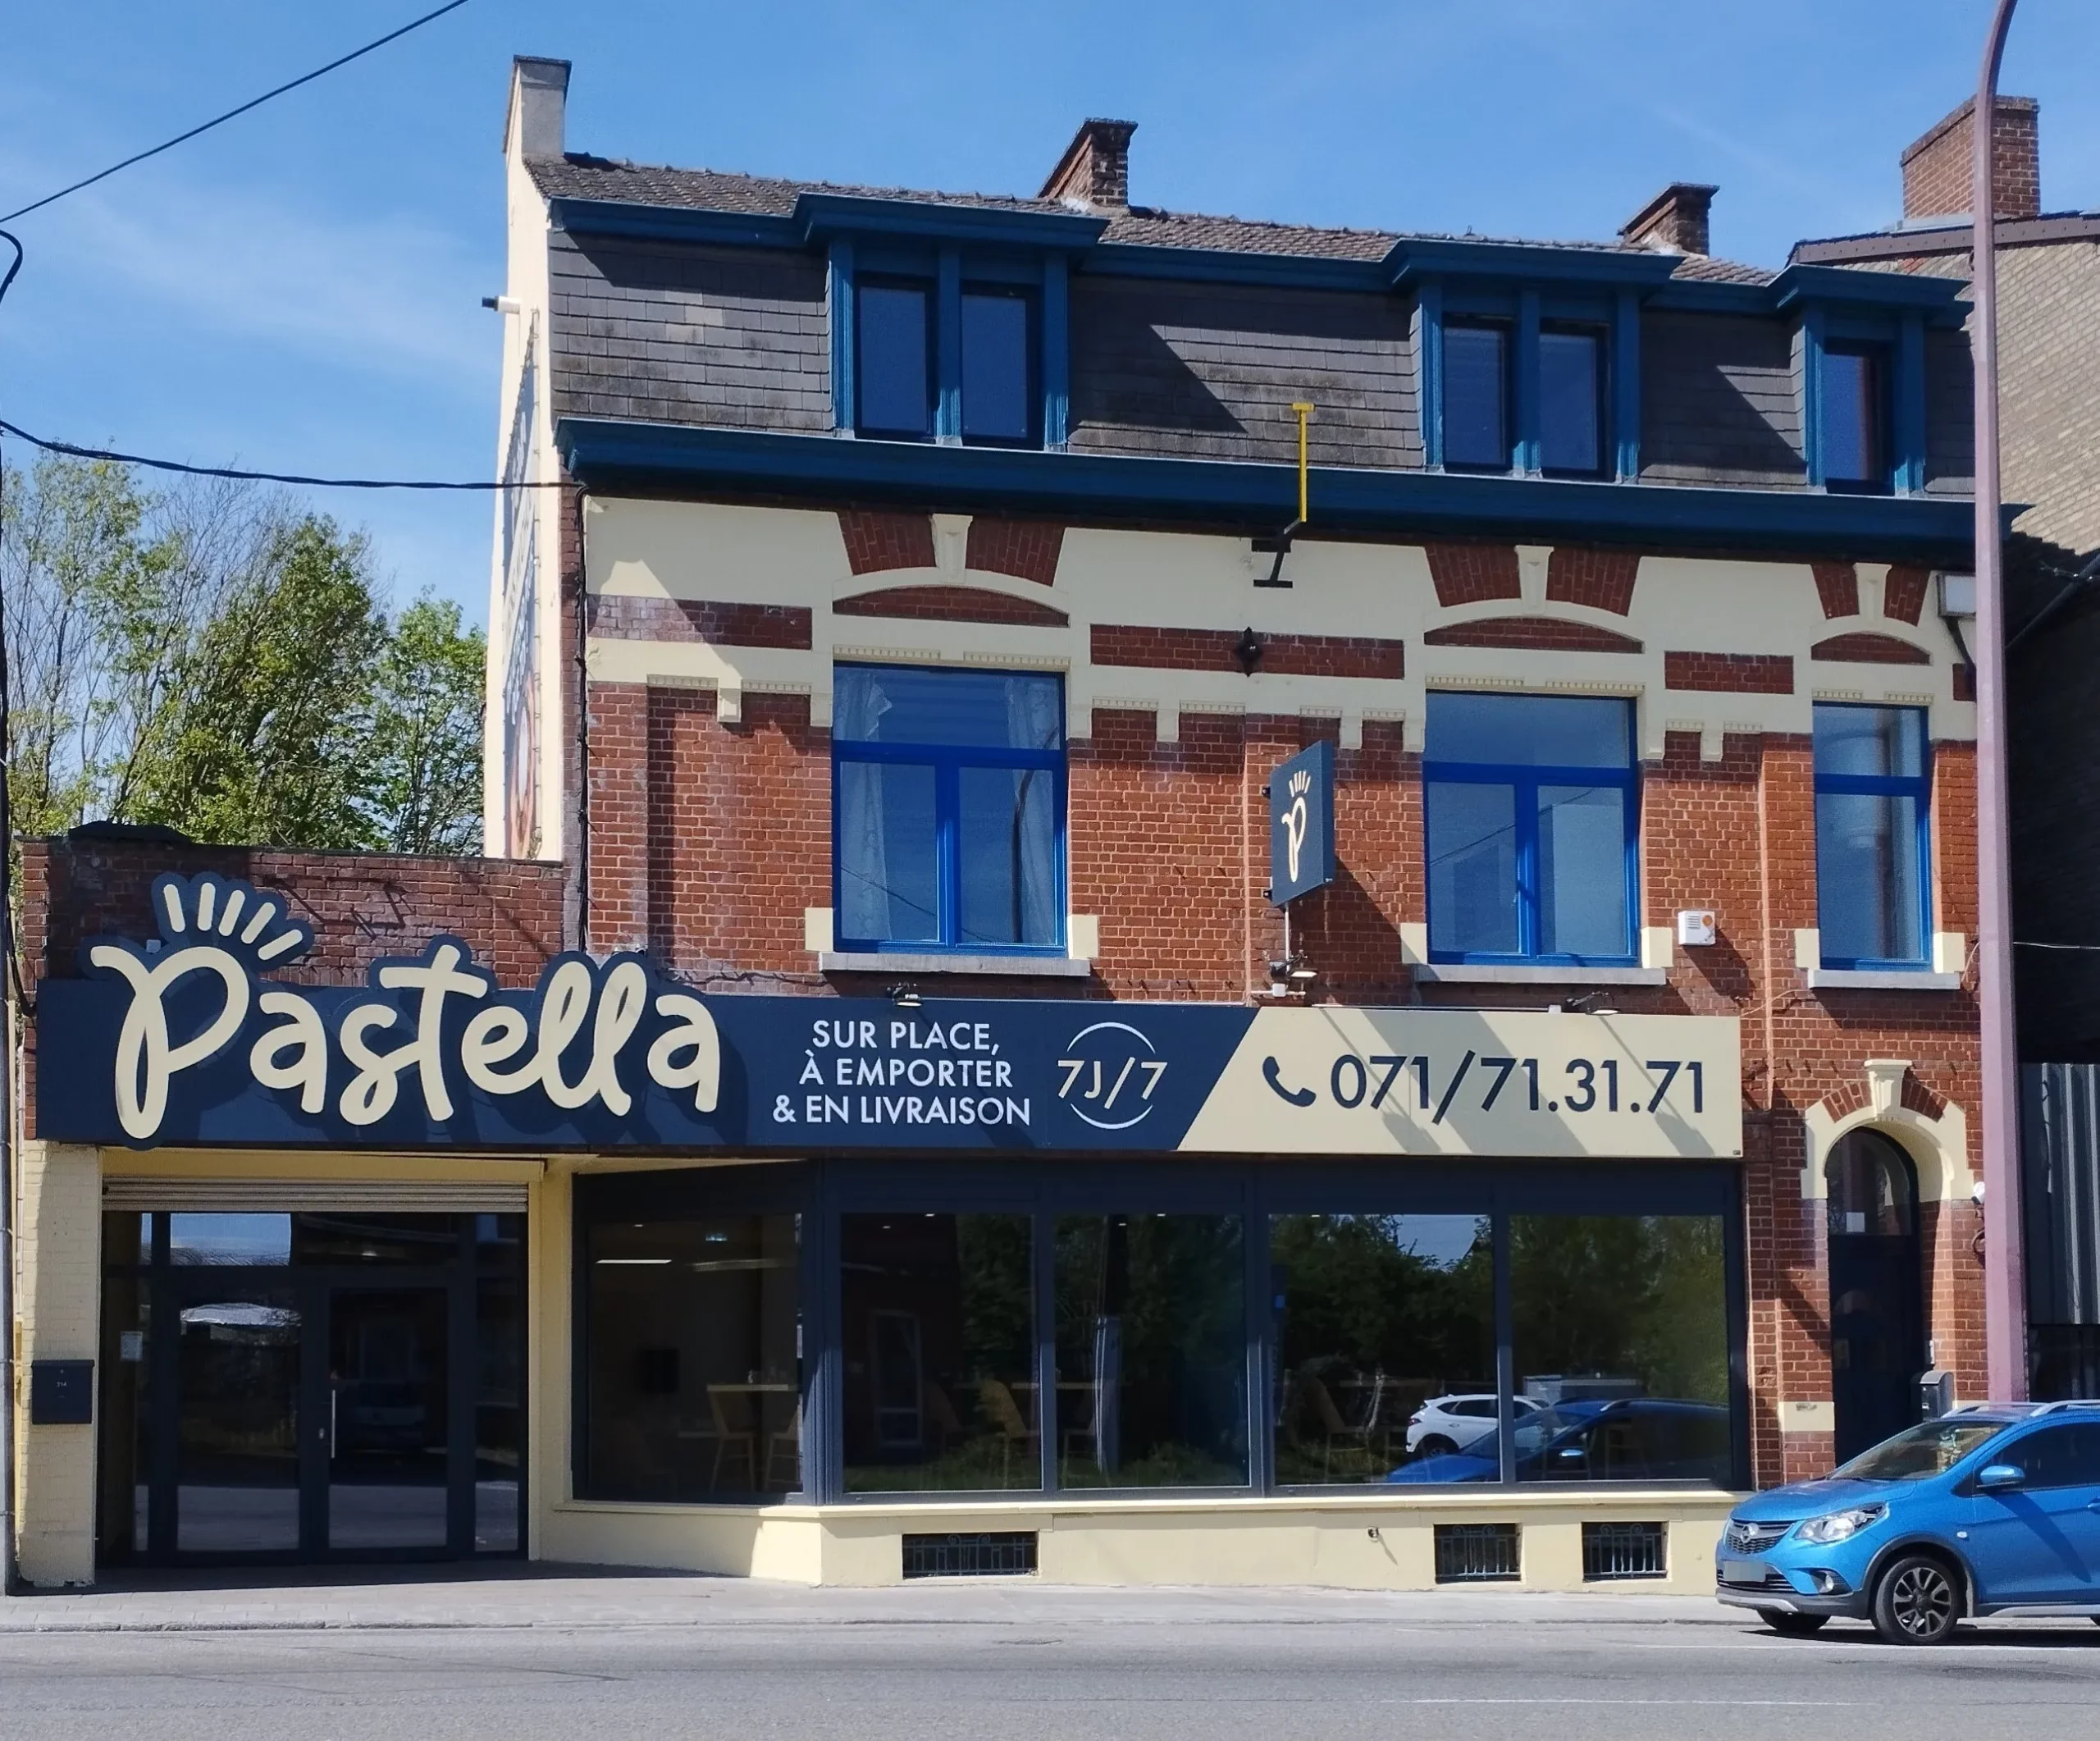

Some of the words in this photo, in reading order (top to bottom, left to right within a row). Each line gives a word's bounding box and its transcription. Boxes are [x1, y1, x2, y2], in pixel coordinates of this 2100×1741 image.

[812, 1020, 878, 1049] SUR
[890, 1021, 1000, 1056] PLACE,
[799, 1050, 824, 1085] À
[837, 1058, 1013, 1088] EMPORTER
[1057, 1057, 1168, 1110] 7J/7
[1331, 1049, 1703, 1126] 071/71.31.71
[773, 1094, 797, 1122] &
[806, 1094, 849, 1124] EN
[861, 1096, 1030, 1126] LIVRAISON
